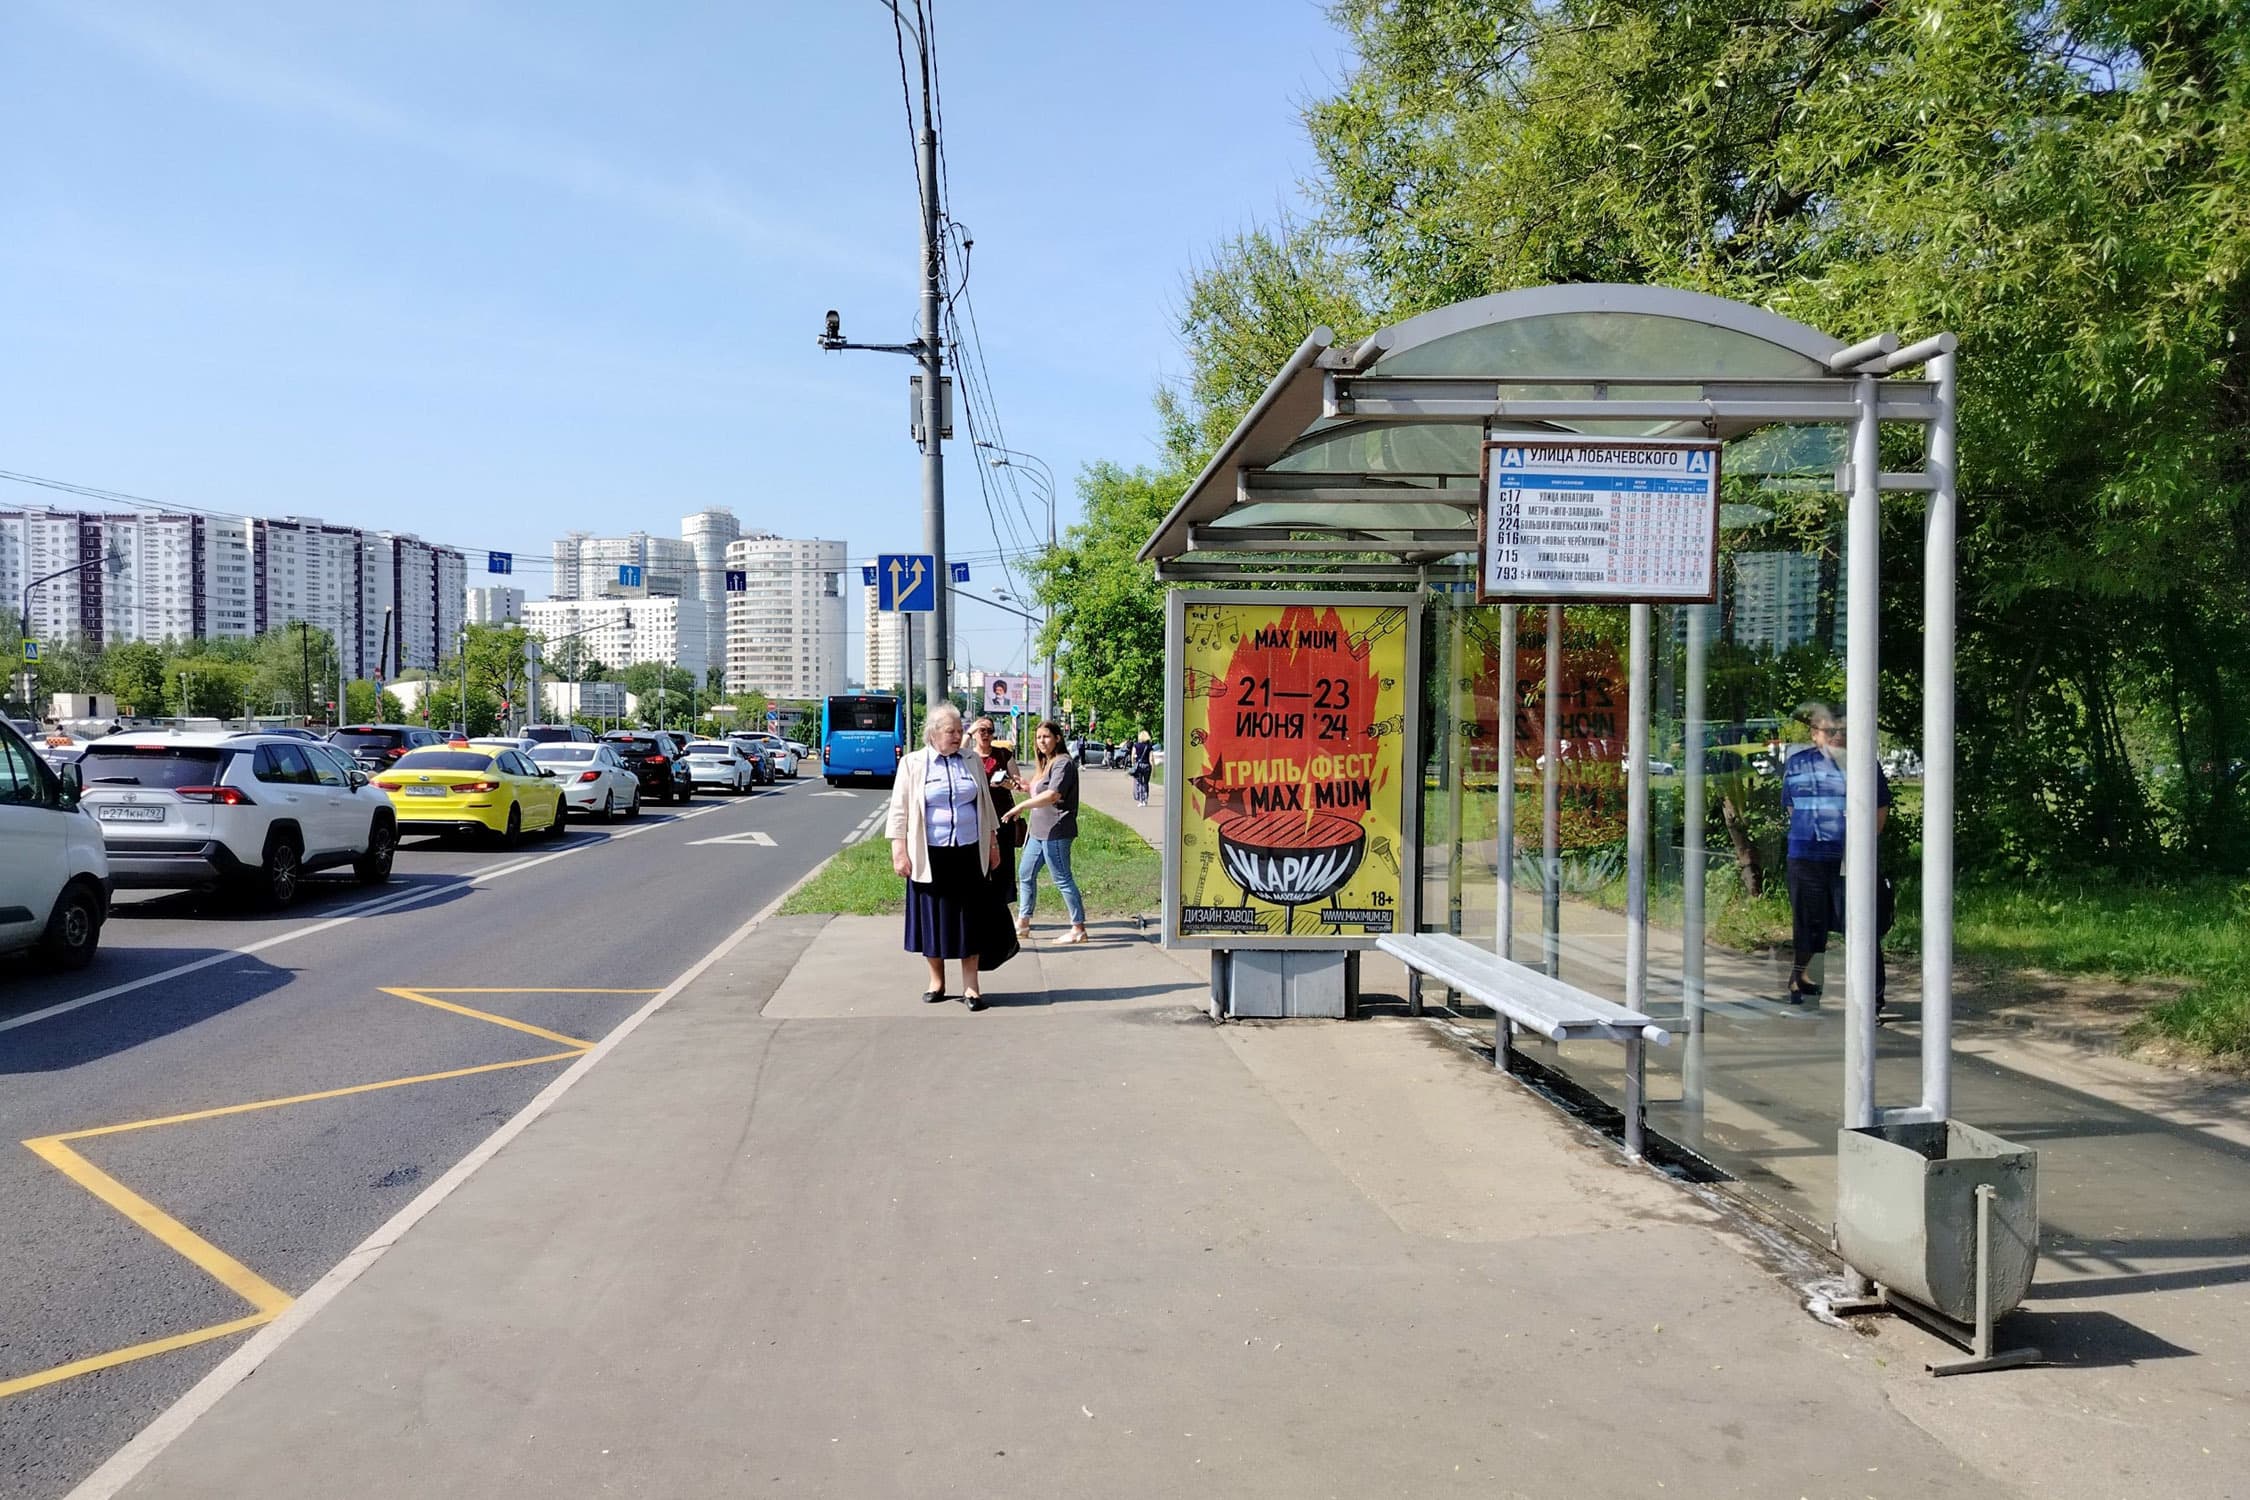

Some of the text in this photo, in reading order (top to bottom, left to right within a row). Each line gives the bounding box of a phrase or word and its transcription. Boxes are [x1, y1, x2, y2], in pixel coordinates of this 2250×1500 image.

[1530, 449, 1677, 465] УЛИЦА ЛОБАЧЕВСКОГО
[1500, 490, 1521, 502] с17
[1539, 493, 1559, 503] УЛИЦА
[1500, 504, 1520, 516] т34
[1528, 506, 1549, 516] МЕТРО
[1498, 518, 1520, 531] 224
[1520, 520, 1549, 530] БОЛЬШАЯ
[1589, 521, 1609, 532] УЛИЦА
[1498, 532, 1519, 545] 616
[1520, 535, 1541, 545] МЕТРО
[1497, 549, 1518, 562] 715
[1538, 553, 1589, 563] УЛИЦА ЛЕБЕДЕВА
[1496, 567, 1517, 580] 793
[1533, 570, 1573, 581] МИКРОРАЙОН
[1236, 712, 1304, 739] ИЮНЯ
[1224, 752, 1373, 786] ГРИЛЬ ФЕСТ
[1224, 844, 1354, 893] ЖАРИМ
[1371, 891, 1394, 906] 18+
[1184, 908, 1254, 924] ДИЗАЙН ЗАВОД
[1322, 910, 1392, 922] WWW.MAXIMUM.RU
